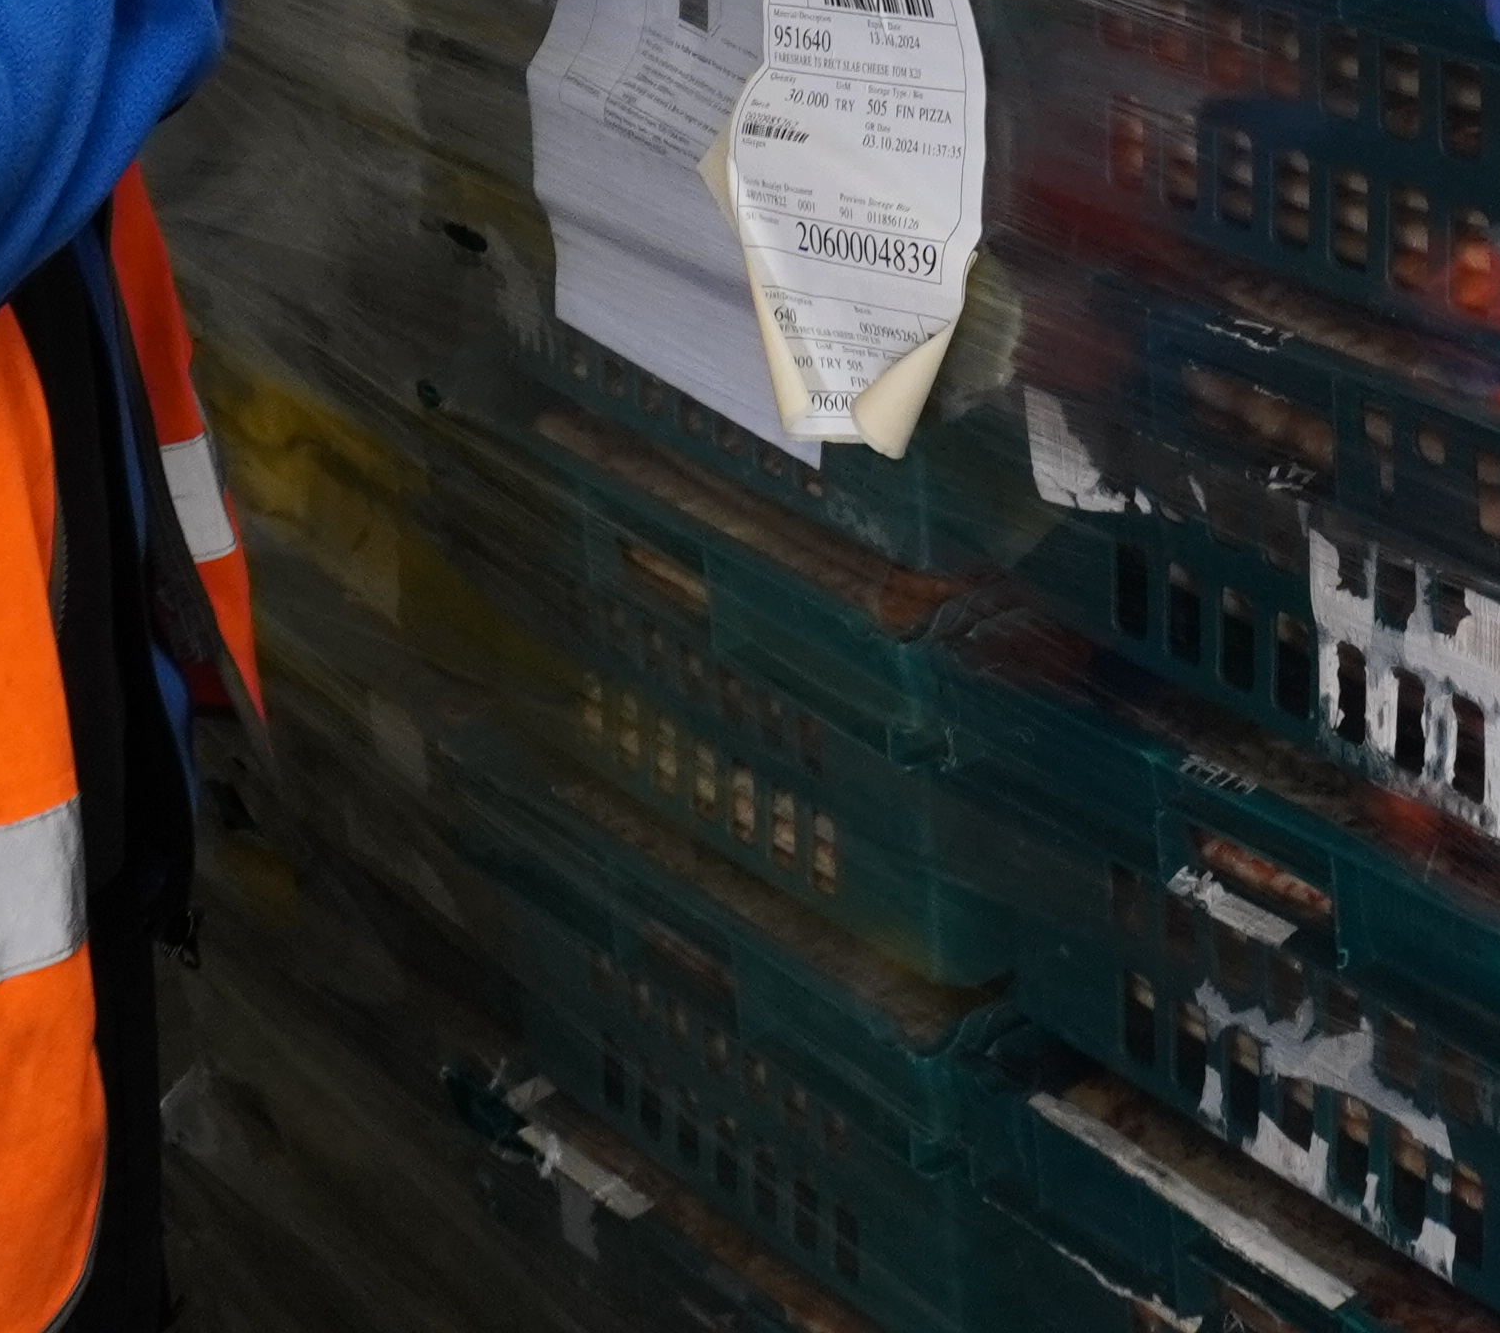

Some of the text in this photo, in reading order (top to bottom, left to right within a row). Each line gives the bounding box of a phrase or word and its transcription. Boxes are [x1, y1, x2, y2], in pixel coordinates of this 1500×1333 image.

[774, 25, 831, 53] 951640
[784, 88, 952, 124] 30.000 TRY 505 FIN PIZZA
[862, 134, 962, 159] 03.10.2024 11:37:35
[795, 221, 937, 276] 2060004839
[820, 357, 841, 369] TRY
[846, 359, 863, 371] 505
[850, 376, 869, 389] FIN
